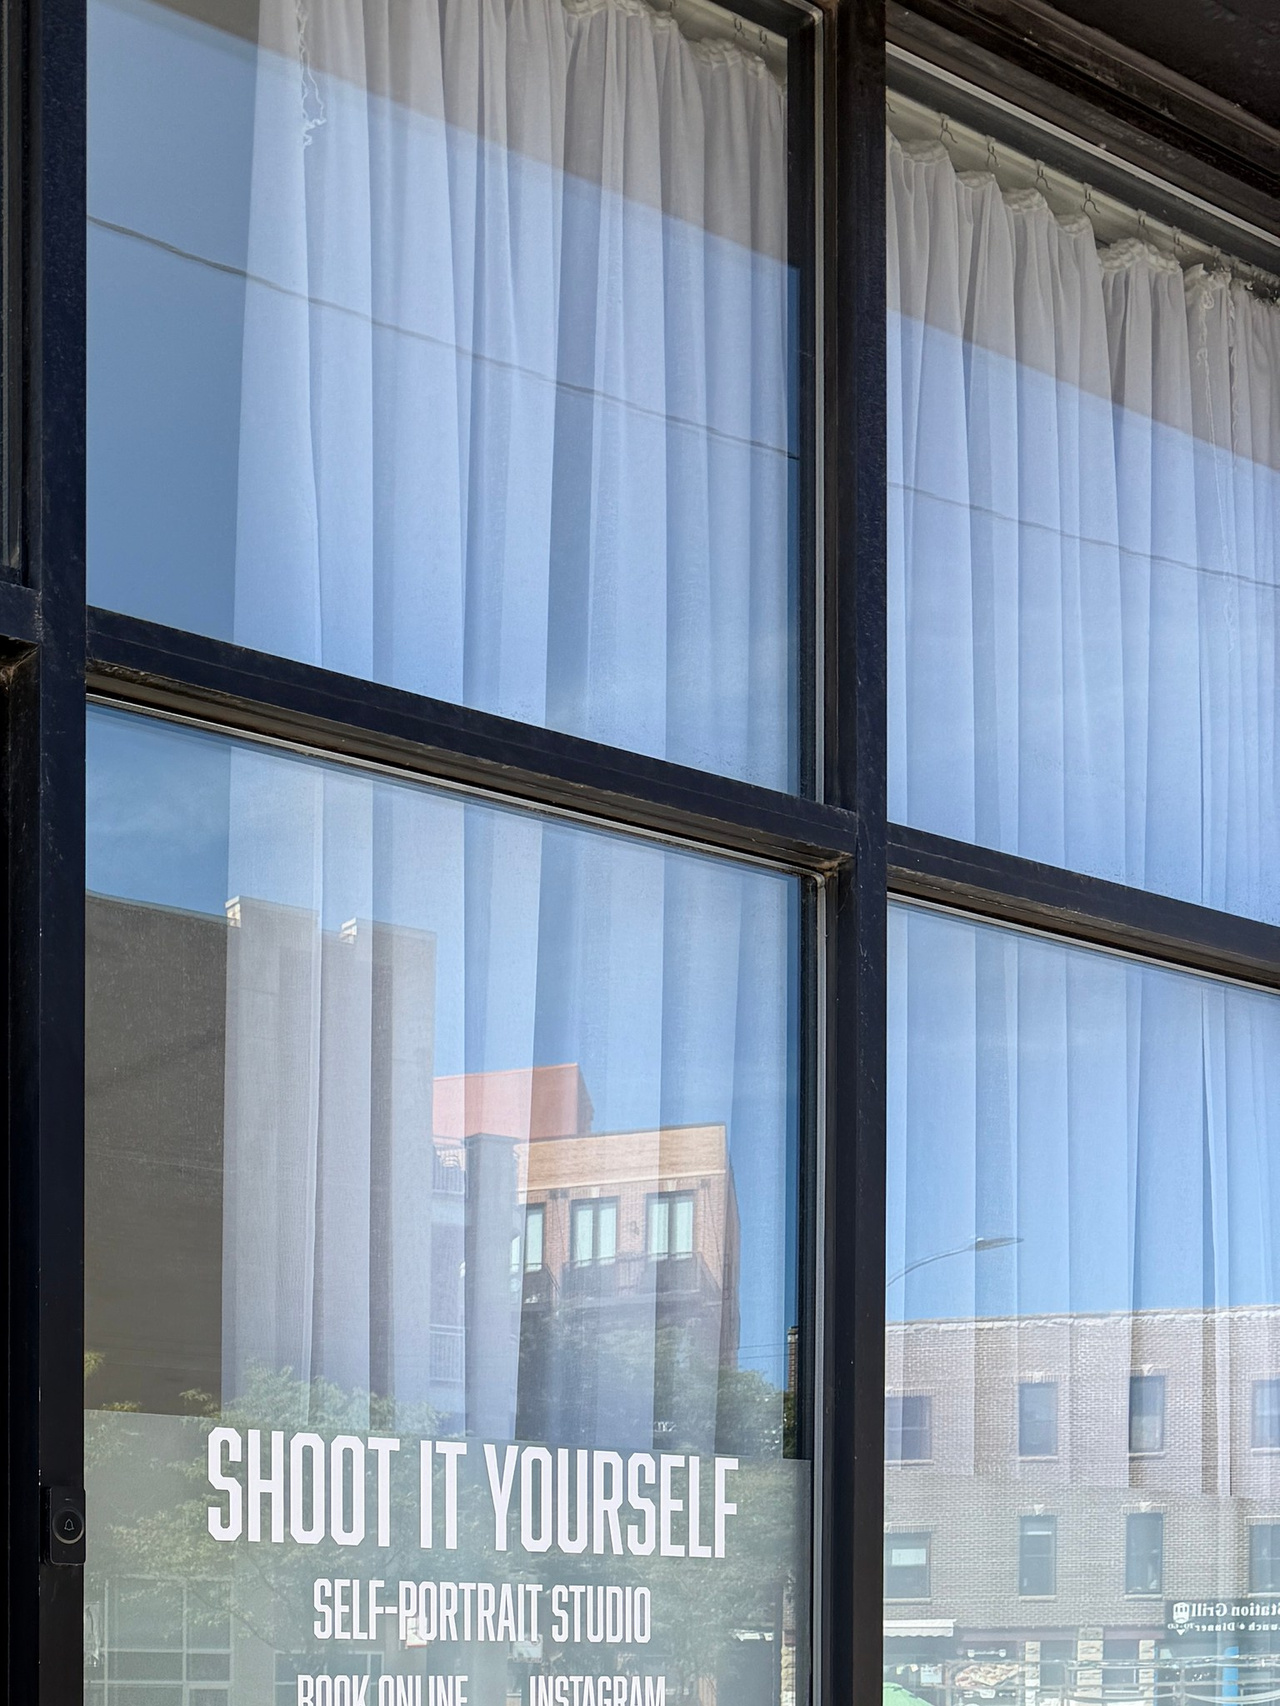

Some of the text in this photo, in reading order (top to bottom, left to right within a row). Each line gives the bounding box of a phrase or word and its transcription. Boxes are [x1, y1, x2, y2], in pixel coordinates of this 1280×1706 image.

[207, 1427, 739, 1559] SHOOT IT YOURSELF
[313, 1578, 651, 1644] SELF-PORTRAIT STUDIO
